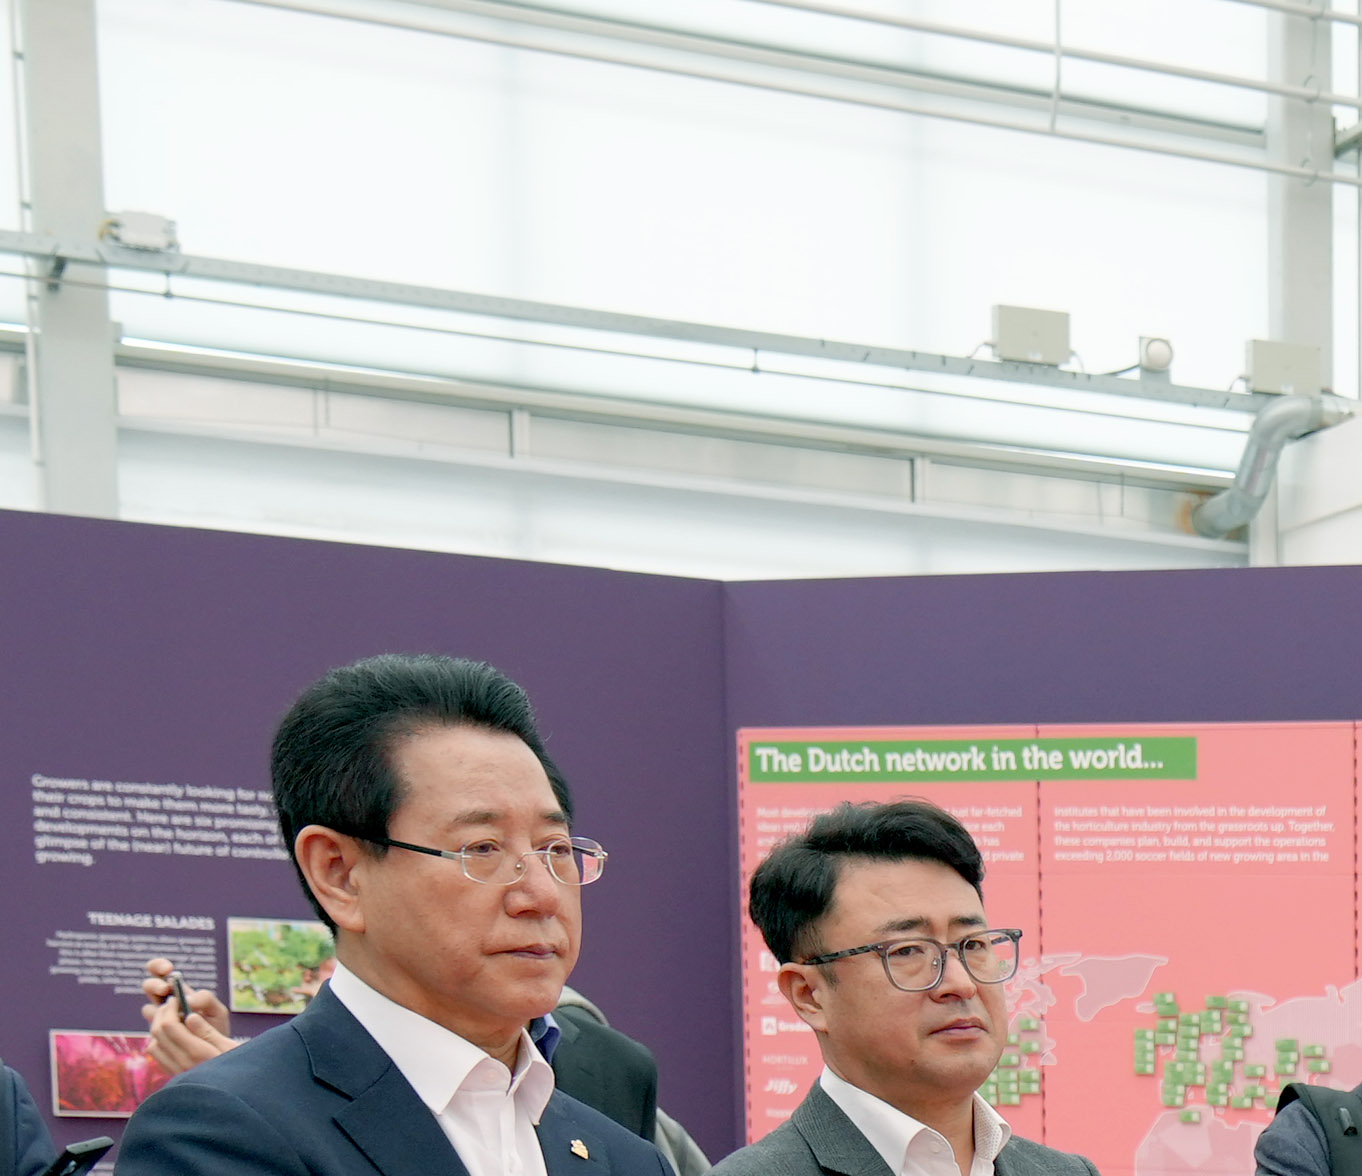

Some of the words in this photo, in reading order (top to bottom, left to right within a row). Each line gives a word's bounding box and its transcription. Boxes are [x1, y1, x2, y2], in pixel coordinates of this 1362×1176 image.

[756, 747, 802, 772] The
[807, 747, 880, 772] Dutch
[885, 746, 986, 772] network
[991, 745, 1017, 770] in
[1021, 744, 1063, 770] the
[1069, 743, 1164, 770] world...
[32, 773, 90, 790] Growers
[91, 779, 113, 792] are
[115, 781, 184, 799] constantly
[186, 784, 235, 803] looking
[237, 787, 256, 801] for
[32, 788, 65, 804] their
[66, 792, 106, 807] crops
[107, 794, 122, 808] to
[124, 796, 161, 810] make
[162, 797, 198, 812] them
[199, 802, 235, 815] more
[33, 805, 61, 819] and
[136, 811, 169, 826] Here
[170, 813, 193, 827] are
[971, 806, 1022, 817] far-fetched
[1100, 806, 1119, 817] that
[1121, 806, 1145, 817] have
[1147, 806, 1171, 817] been
[1174, 806, 1216, 817] involved
[1217, 806, 1227, 817] in
[1229, 806, 1246, 817] the
[1248, 805, 1313, 818] development
[1315, 805, 1327, 817] of
[33, 819, 129, 838] developments
[130, 827, 150, 839] on
[151, 826, 174, 841] the
[982, 822, 1005, 833] each
[1055, 821, 1071, 832] the
[1073, 820, 1129, 832] horticulture
[1132, 820, 1171, 834] industry
[1174, 821, 1197, 832] from
[1200, 820, 1216, 832] the
[1219, 820, 1269, 834] grassroots
[1288, 819, 1335, 834] Together,
[34, 835, 89, 851] glimpse
[90, 837, 106, 850] of
[107, 837, 130, 852] the
[173, 841, 214, 857] future
[215, 844, 230, 858] of
[984, 837, 1000, 847] has
[1055, 836, 1082, 847] these
[1083, 836, 1135, 848] companies
[1138, 836, 1163, 849] plan,
[1164, 836, 1191, 848] build,
[1193, 836, 1212, 847] and
[1215, 836, 1252, 849] support
[1255, 835, 1270, 847] the
[1273, 835, 1326, 849] operations
[34, 850, 96, 867] growing.
[992, 850, 1024, 863] private
[1055, 851, 1104, 864] exceeding
[1135, 852, 1167, 862] soccer
[1170, 850, 1195, 862] fields
[1197, 850, 1208, 862] of
[1210, 852, 1231, 862] new
[1234, 852, 1274, 865] growing
[1277, 852, 1298, 862] area
[1301, 851, 1310, 862] in
[1313, 851, 1329, 862] the
[87, 911, 153, 928] TEENAGE
[154, 914, 216, 931] SALADES
[764, 1078, 798, 1095] Jiffy
